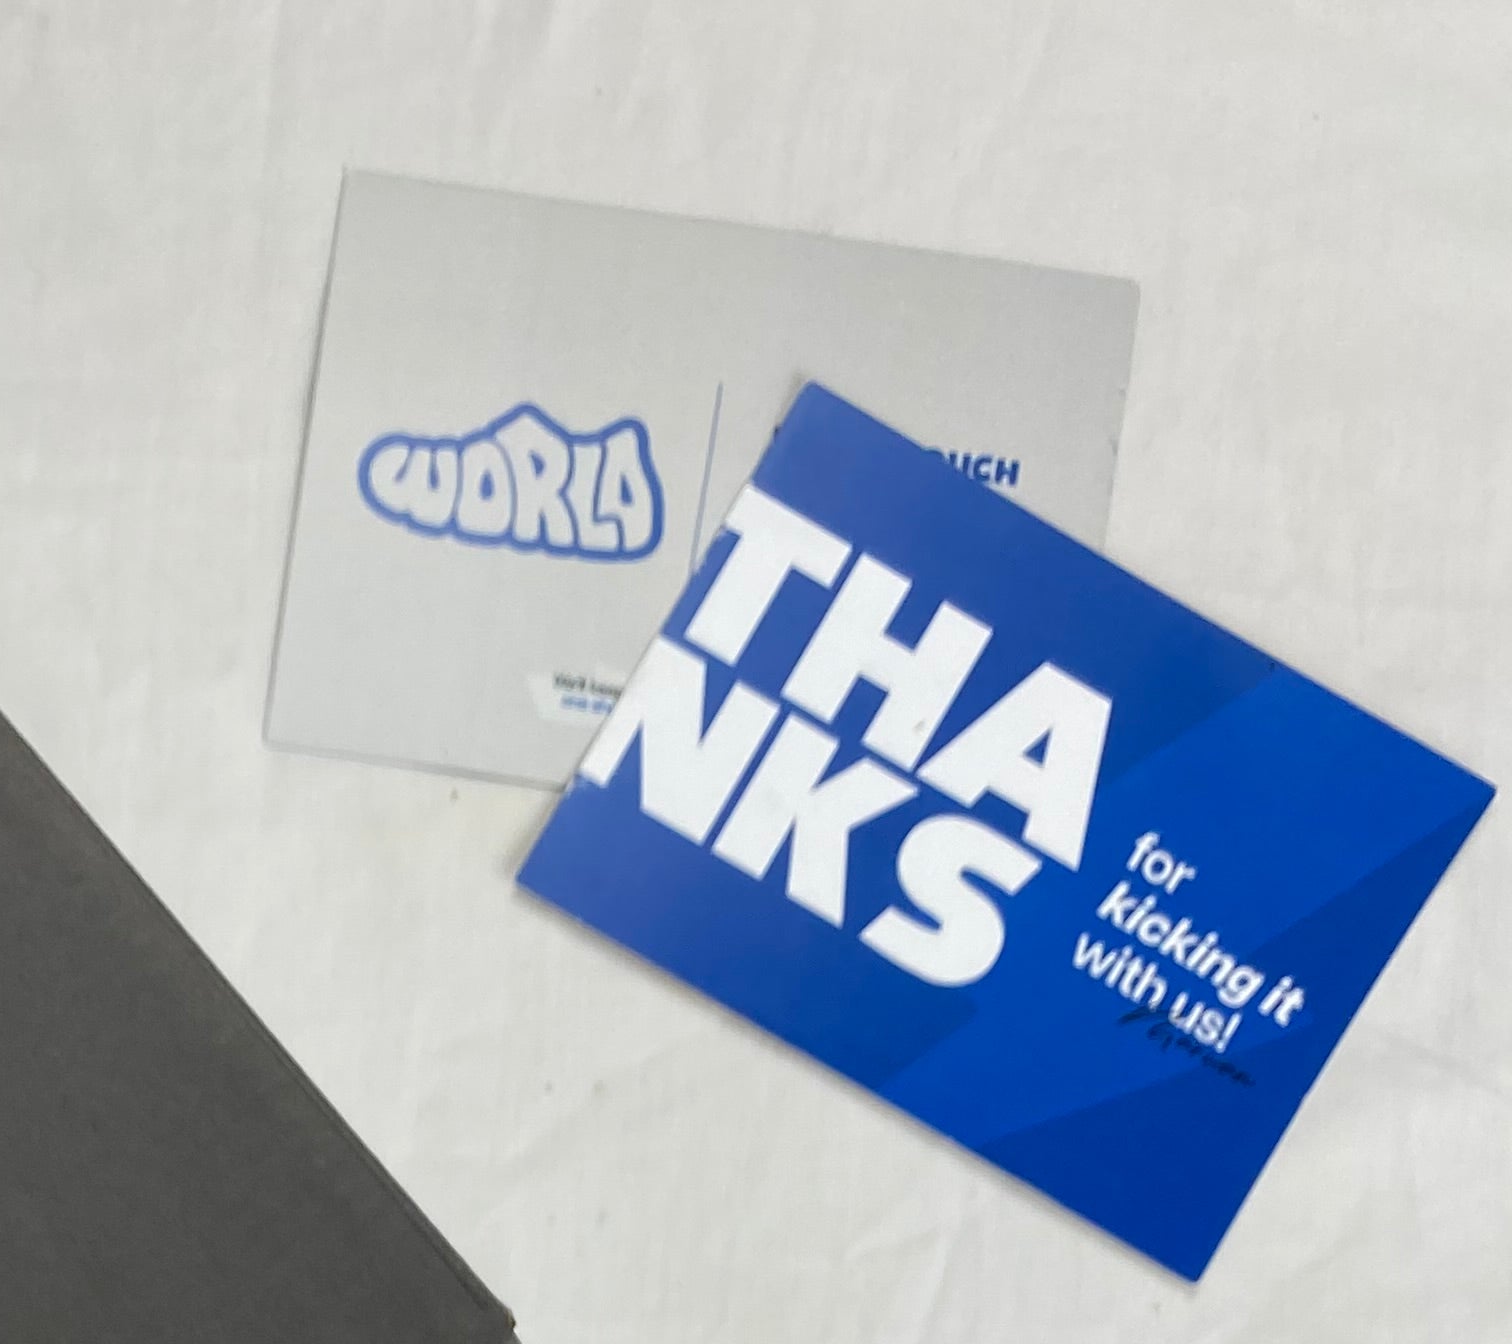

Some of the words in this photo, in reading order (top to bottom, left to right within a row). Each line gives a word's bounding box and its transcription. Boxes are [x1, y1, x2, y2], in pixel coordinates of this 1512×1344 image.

[357, 401, 665, 563] WORLD
[922, 446, 1020, 486] UCH
[685, 483, 1113, 873] THA
[579, 635, 1043, 988] NKS
[1126, 831, 1198, 895] for
[1071, 931, 1168, 1012] with
[1168, 991, 1243, 1054] us!
[1095, 879, 1265, 1009] kicking
[1257, 974, 1306, 1029] it
